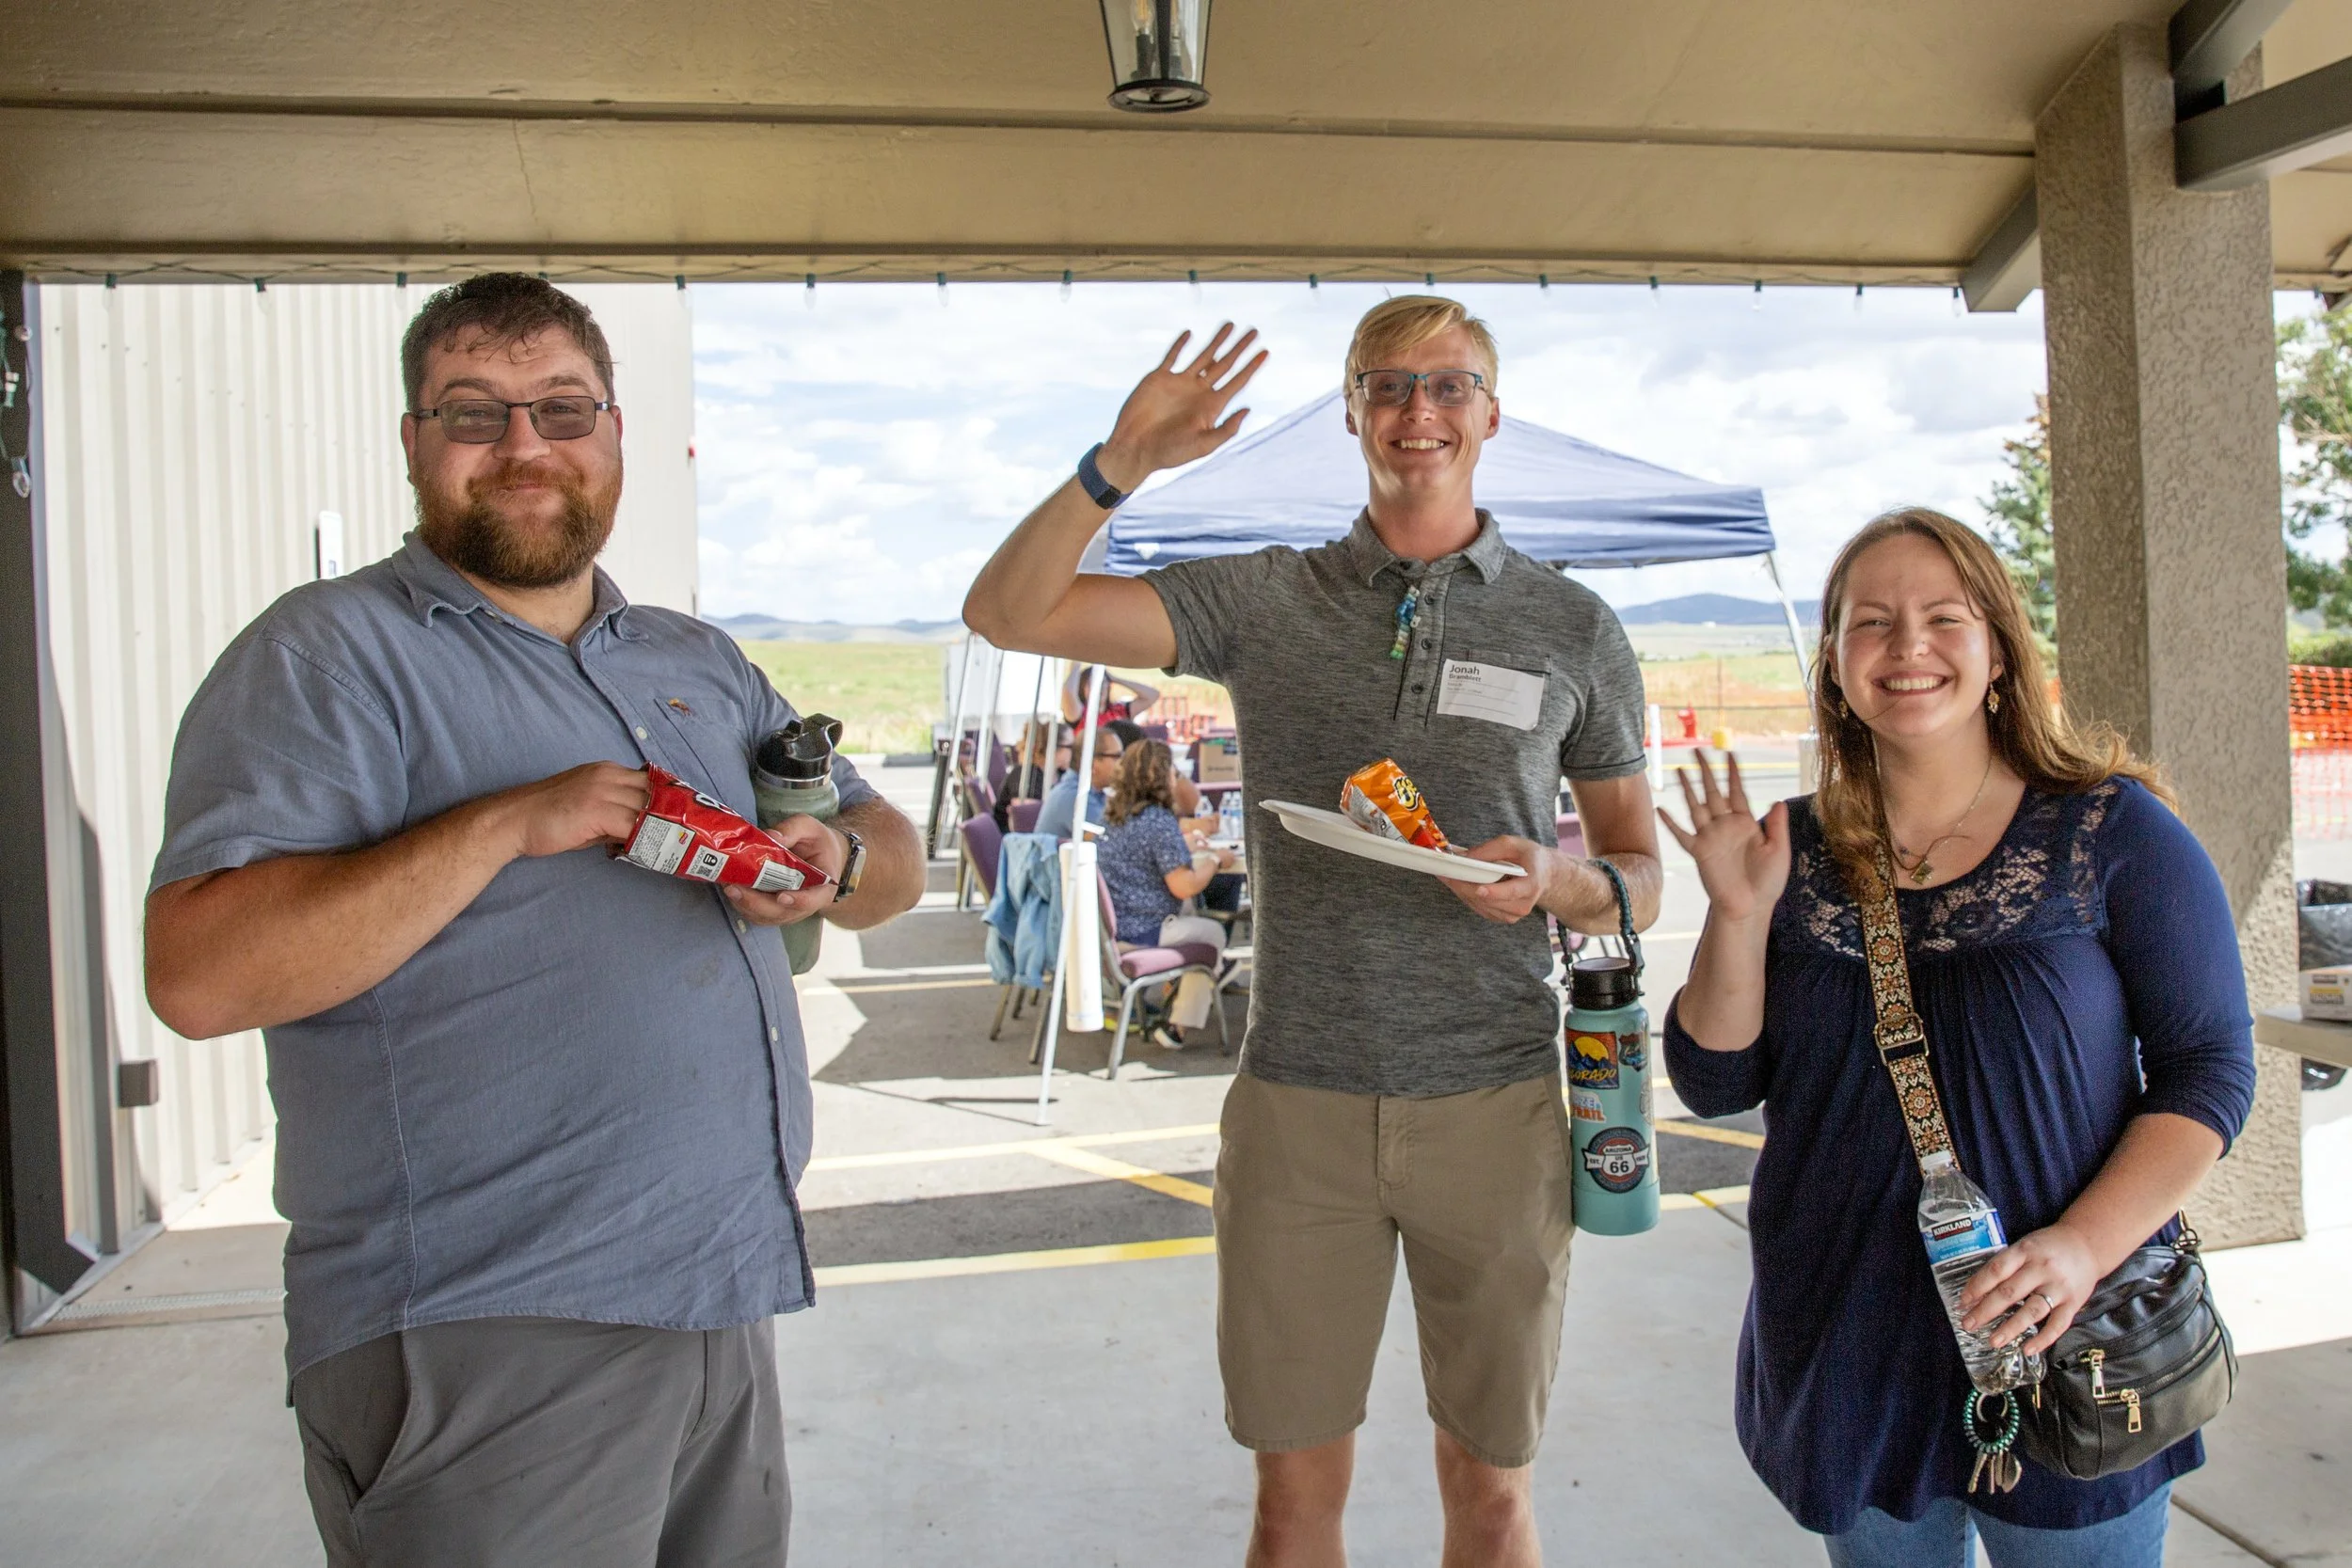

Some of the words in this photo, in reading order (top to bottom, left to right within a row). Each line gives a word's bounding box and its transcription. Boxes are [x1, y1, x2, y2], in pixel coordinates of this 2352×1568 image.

[1450, 664, 1479, 675] Jonah
[1610, 1161, 1629, 1174] 66
[1933, 1219, 1972, 1236] KIRKLAND
